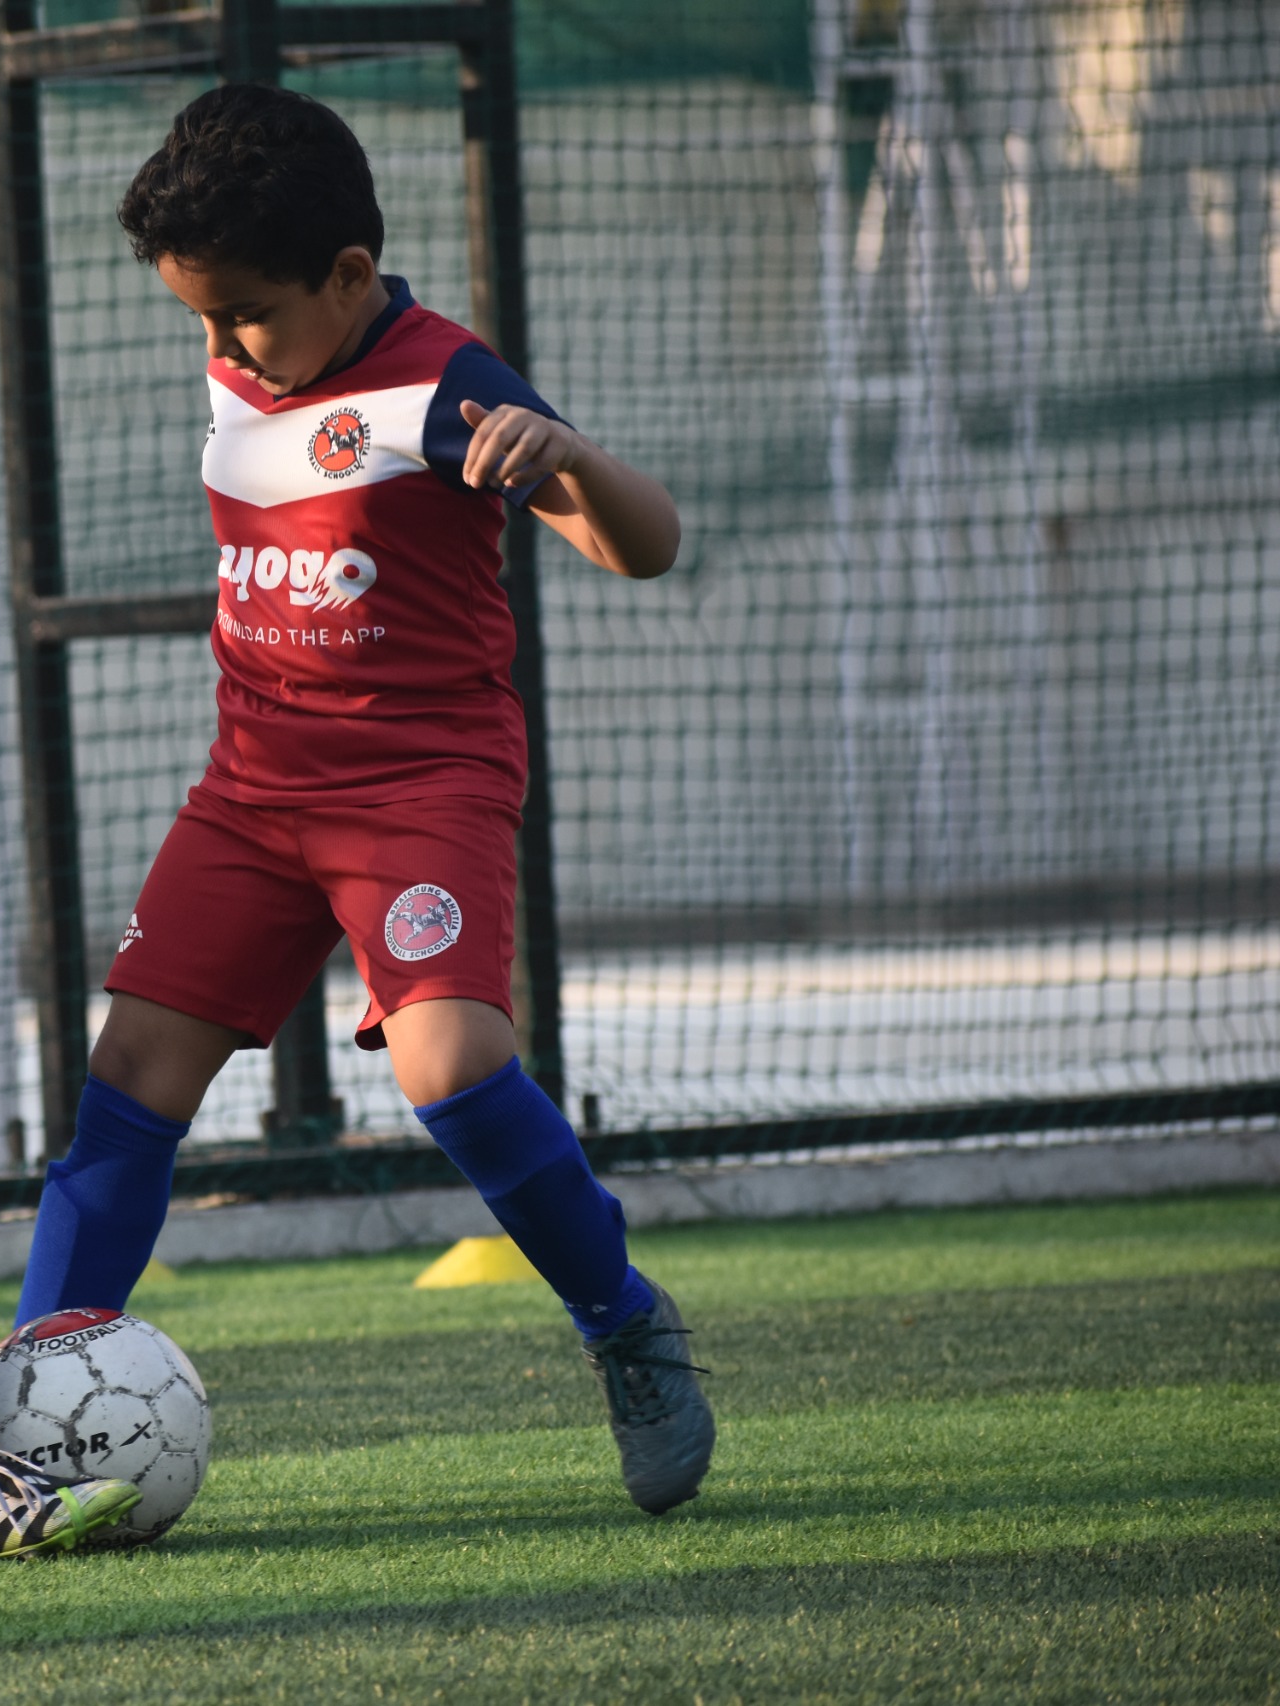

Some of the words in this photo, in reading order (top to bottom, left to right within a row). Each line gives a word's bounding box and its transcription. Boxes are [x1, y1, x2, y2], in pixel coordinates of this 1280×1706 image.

[320, 407, 363, 426] BHAICHUNG
[287, 628, 329, 646] THE
[341, 626, 386, 644] APP
[389, 885, 441, 915] BHAICHUNG
[444, 898, 460, 930] BHUTIA
[386, 925, 406, 958] FOOTBALL
[409, 936, 451, 959] SCHOOLS
[38, 1321, 125, 1353] FOOTBALL
